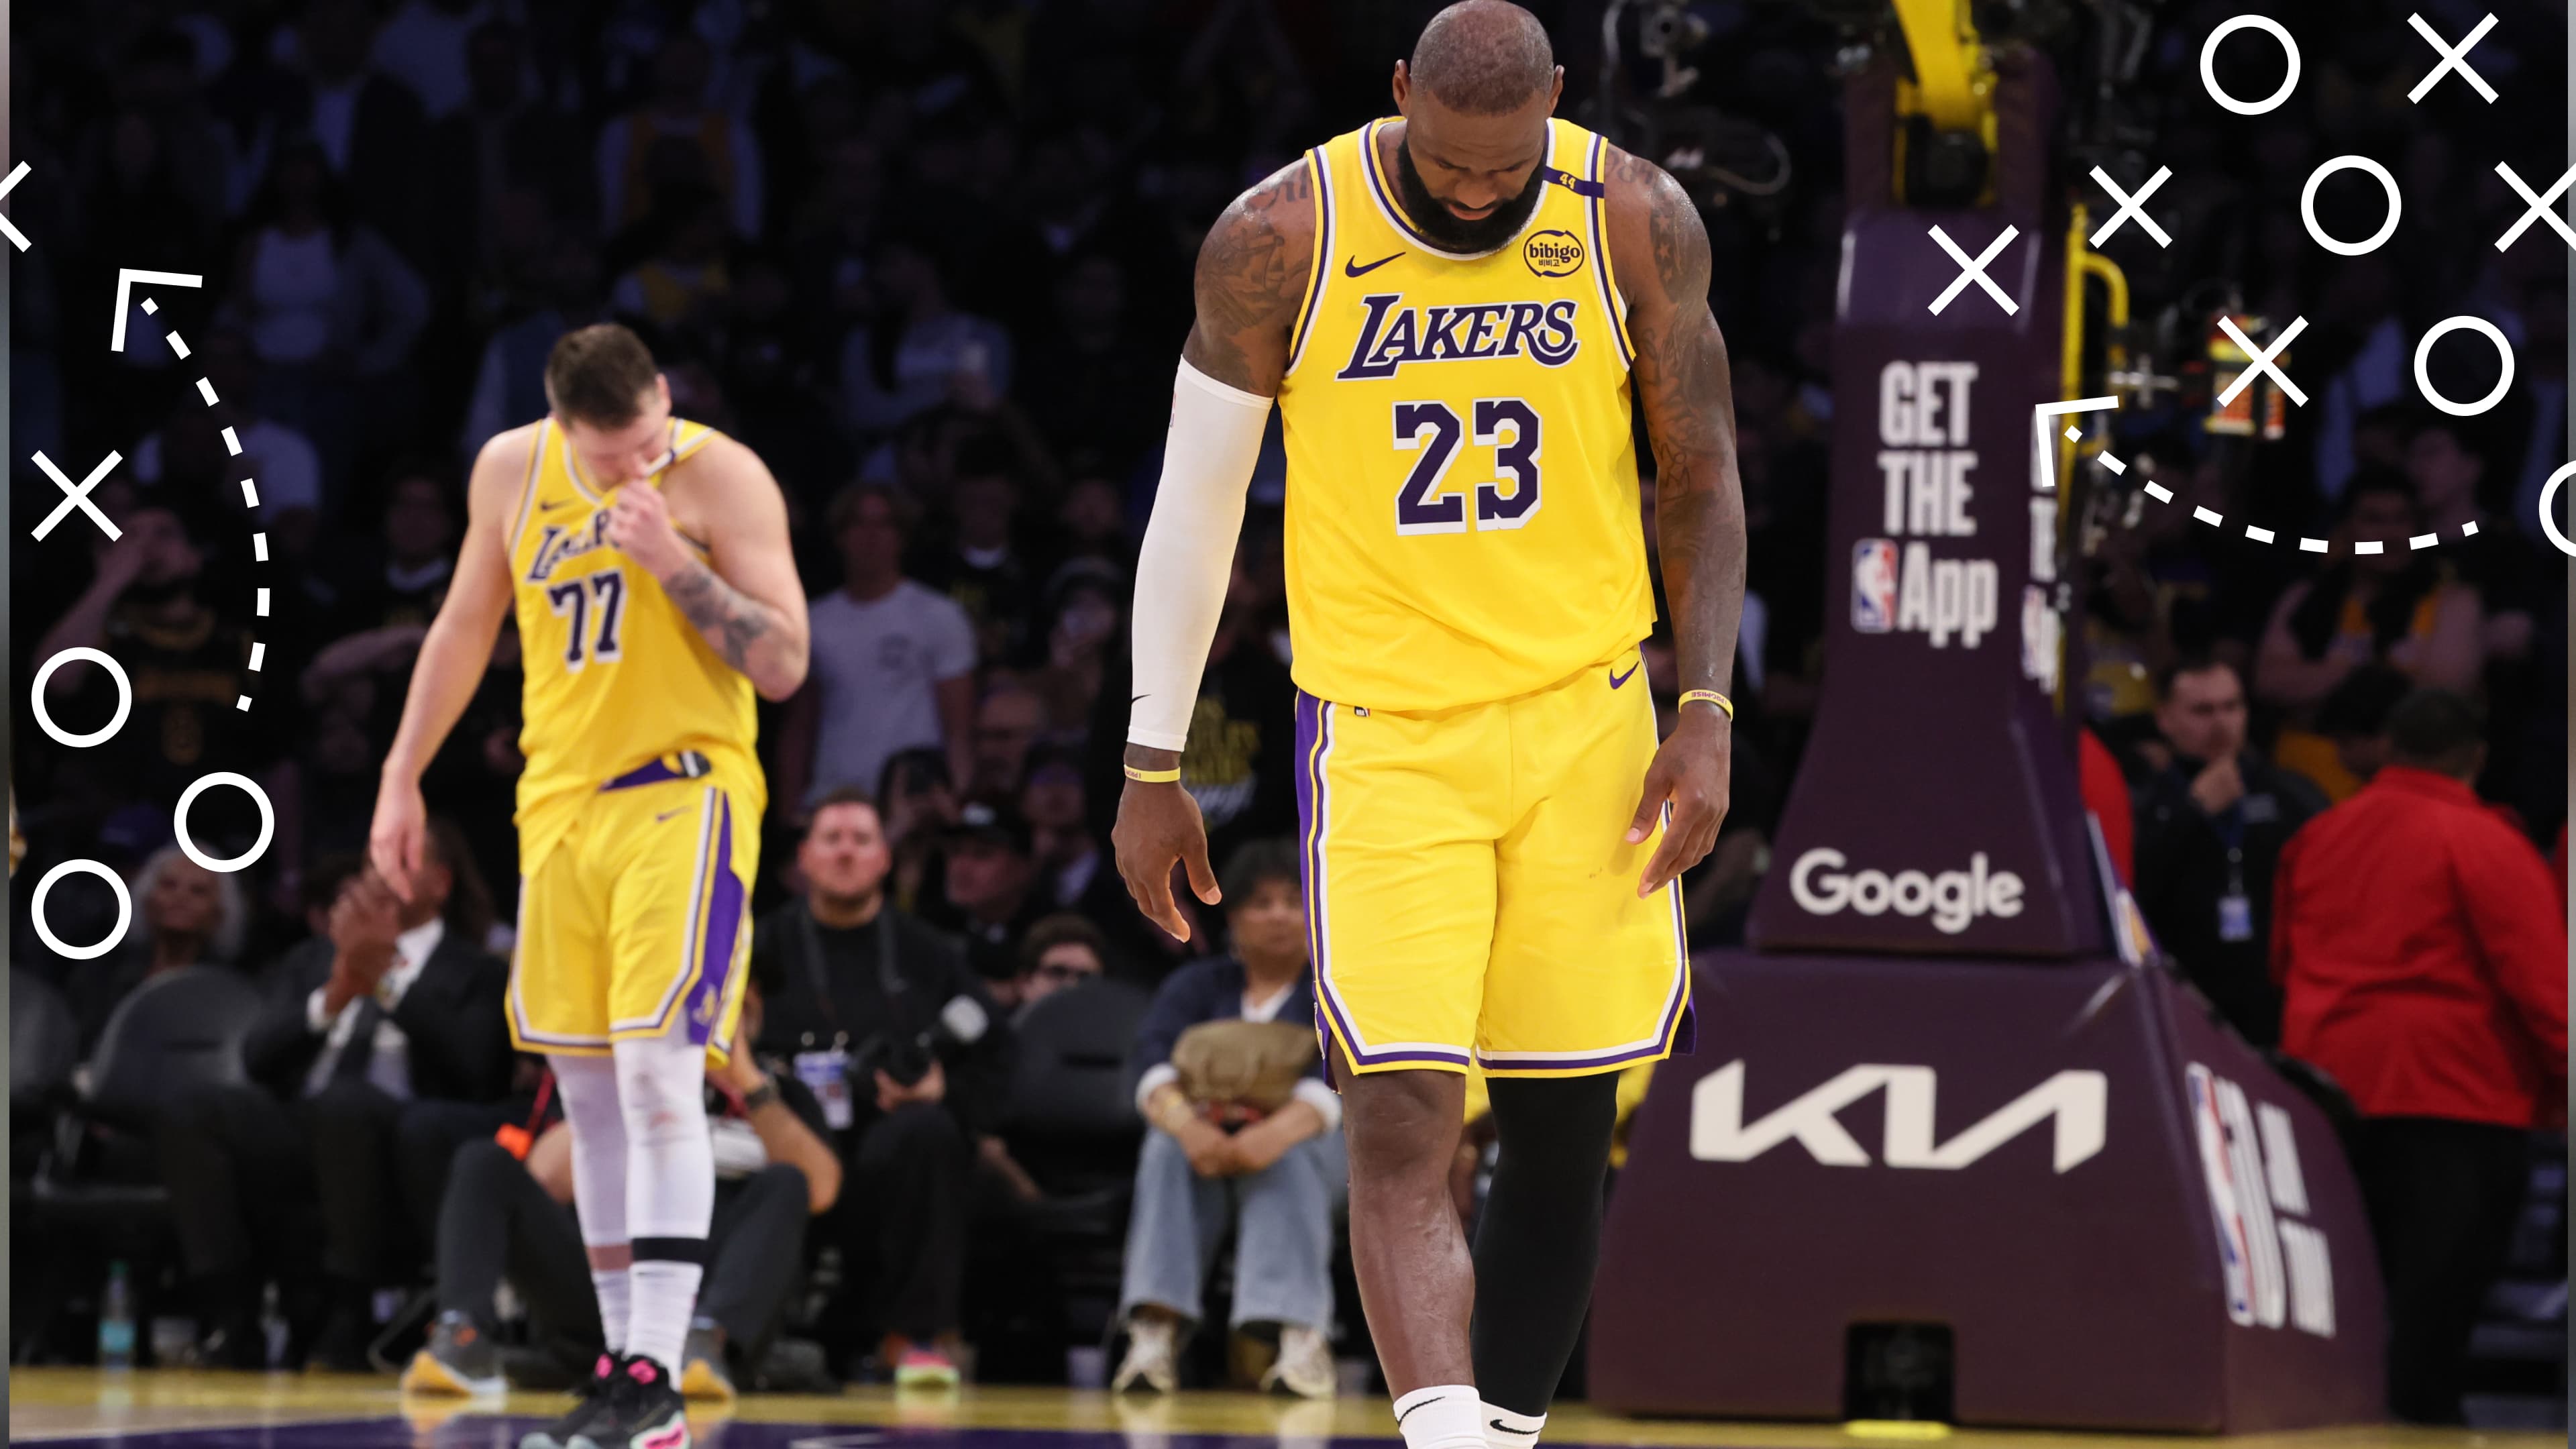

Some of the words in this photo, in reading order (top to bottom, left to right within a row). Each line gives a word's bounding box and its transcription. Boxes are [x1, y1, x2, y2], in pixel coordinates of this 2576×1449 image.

[1559, 173, 1576, 190] 44
[1529, 242, 1581, 264] bibigo
[1335, 292, 1580, 382] LAKERS
[1880, 360, 1979, 447] GET
[1392, 397, 1542, 537] 23
[1877, 451, 1978, 535] THE
[547, 567, 628, 674] 77
[1897, 540, 1999, 649] App
[1790, 847, 2025, 934] Google
[1689, 1058, 2108, 1175] KIA
